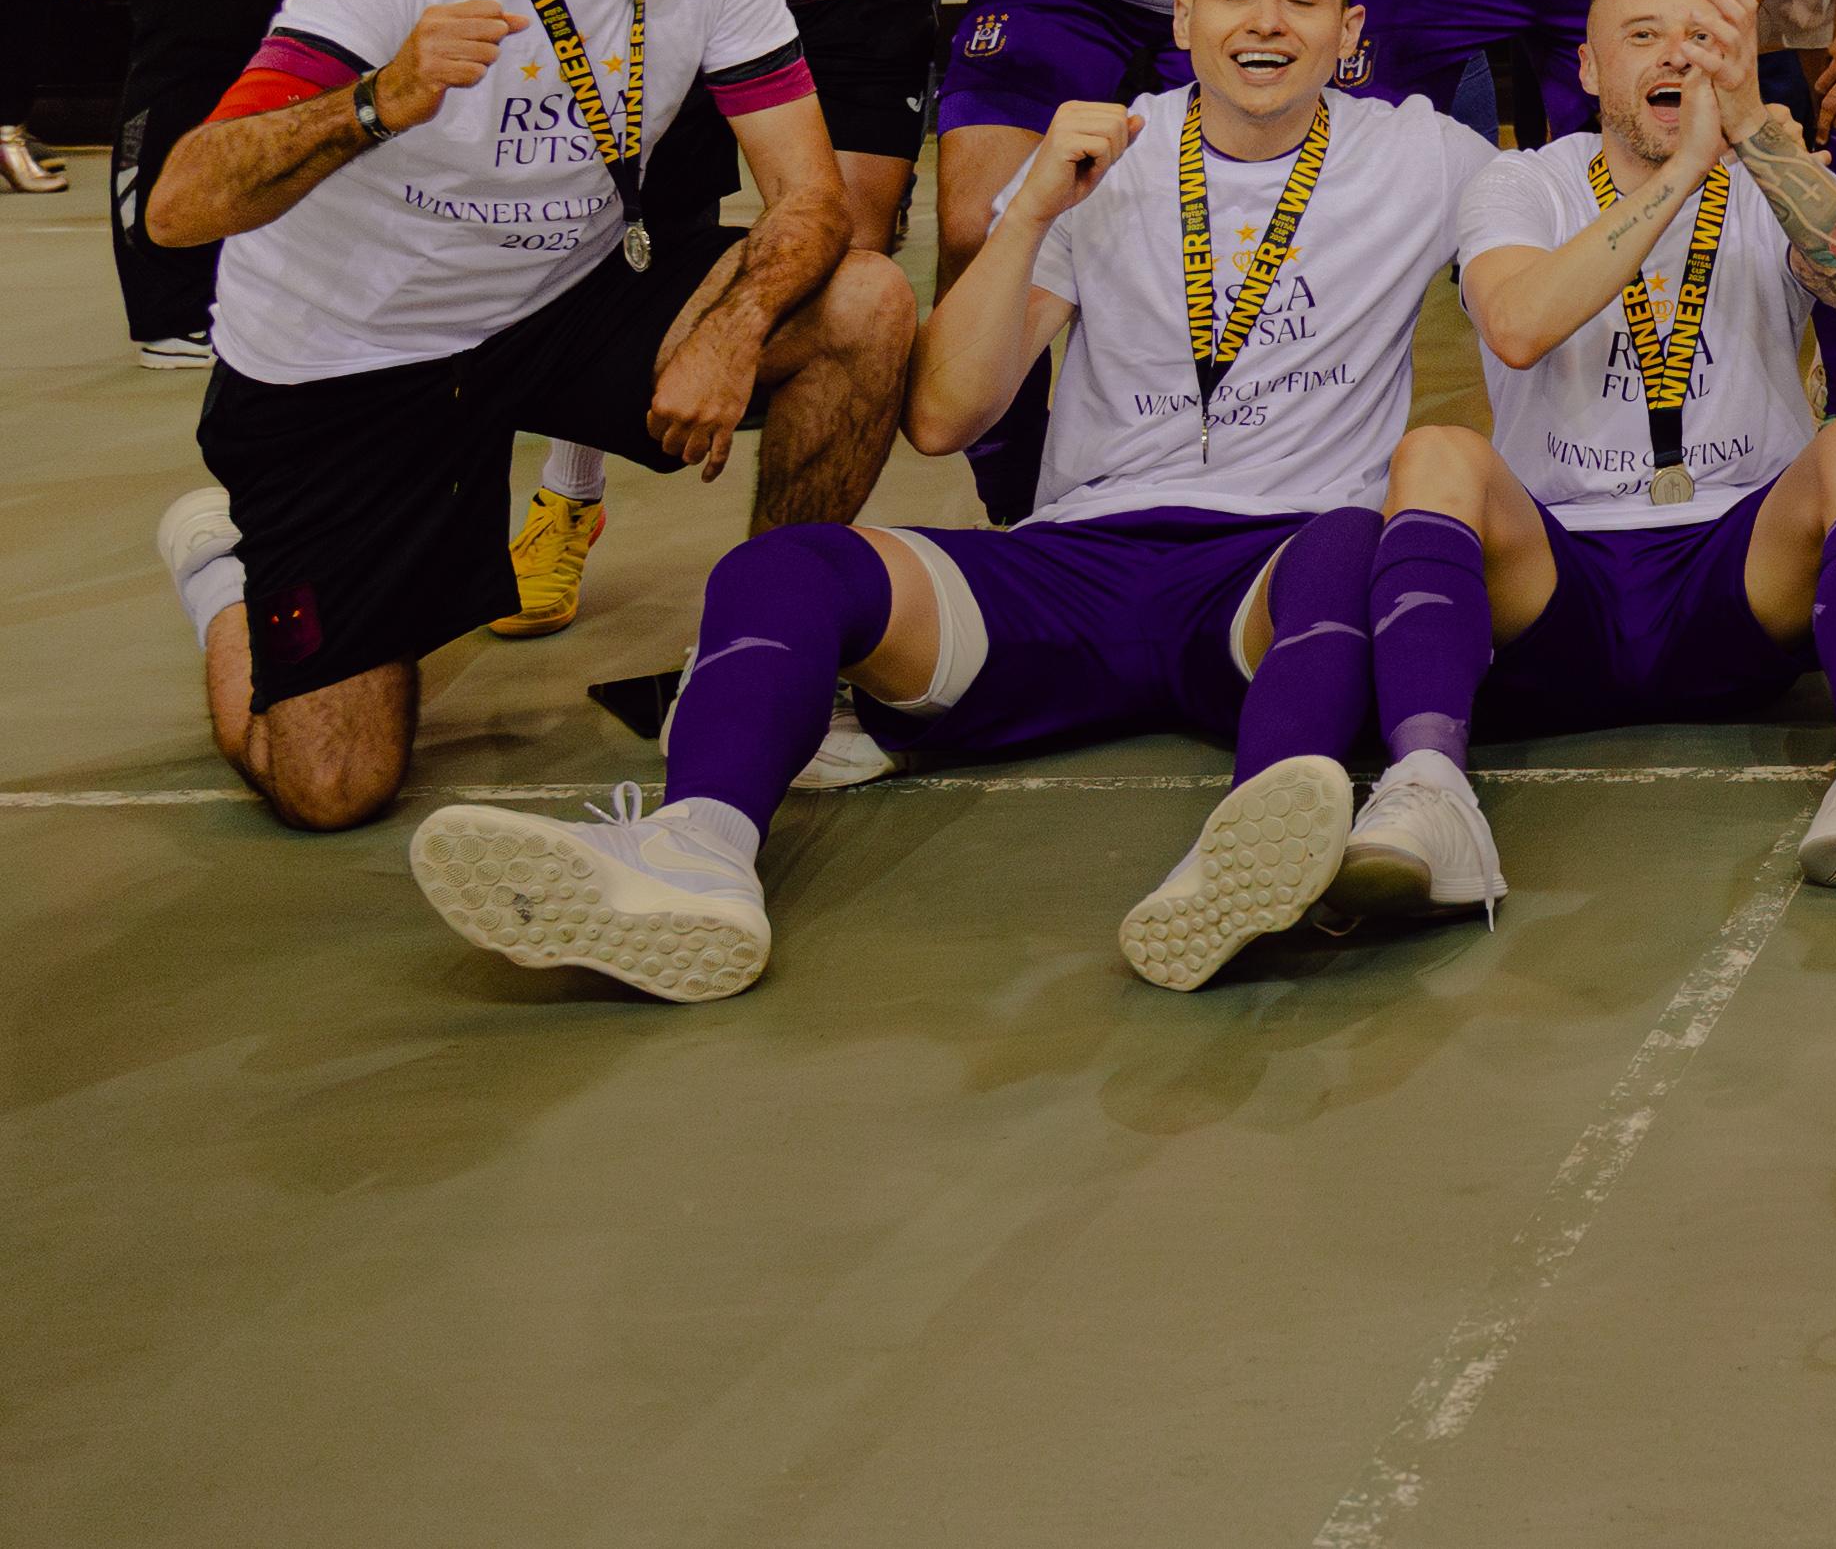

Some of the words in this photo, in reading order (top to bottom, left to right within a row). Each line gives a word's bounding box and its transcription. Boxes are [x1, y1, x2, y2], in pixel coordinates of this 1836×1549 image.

[555, 32, 620, 164] WINNER
[623, 22, 646, 158] WINNER
[404, 184, 532, 225] WINNER
[500, 227, 581, 252] 2025
[1184, 232, 1213, 360] WINNER
[1215, 241, 1287, 363] WINNER
[1657, 283, 1708, 409] WINNER
[1546, 431, 1636, 473] WINNER
